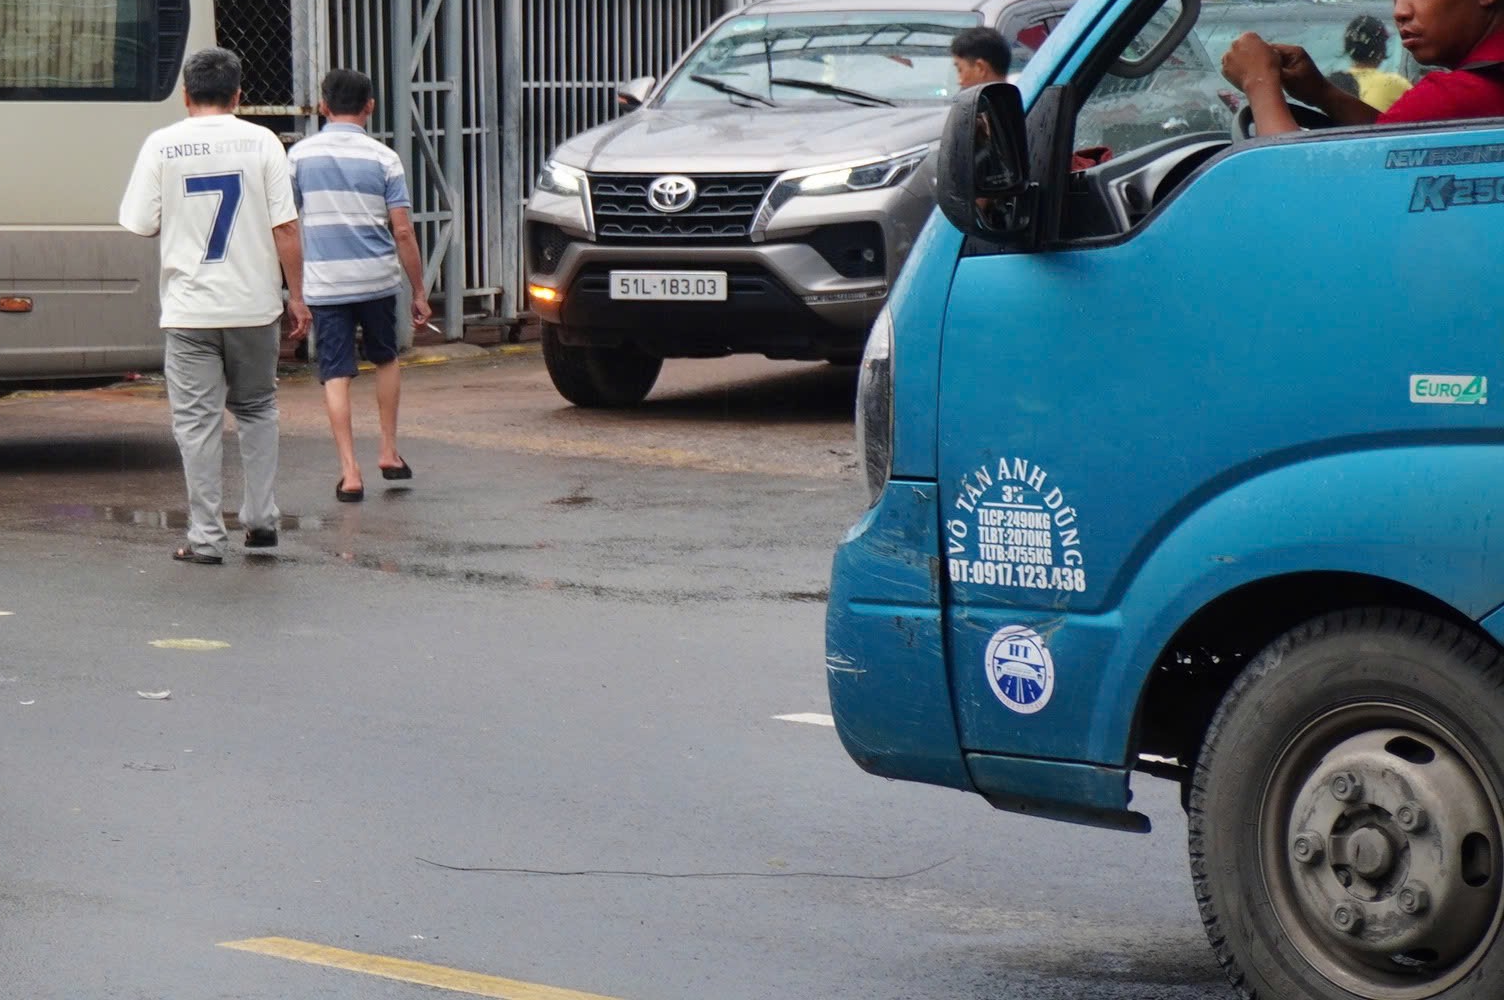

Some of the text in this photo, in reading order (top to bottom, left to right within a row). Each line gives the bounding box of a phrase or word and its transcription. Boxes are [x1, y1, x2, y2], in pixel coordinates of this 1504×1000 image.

[160, 142, 211, 160] ENDER
[1386, 150, 1427, 168] NEW
[182, 169, 244, 265] 7
[620, 278, 717, 296] 51L-183.03
[947, 457, 1084, 567] VÕ TẤN ANH DŨNG
[977, 508, 1051, 530] TLCP:2490KG
[977, 526, 1051, 548] TLBT:2070KG
[948, 558, 1087, 593] ĐT:0917.123.438
[1009, 643, 1032, 659] HT
